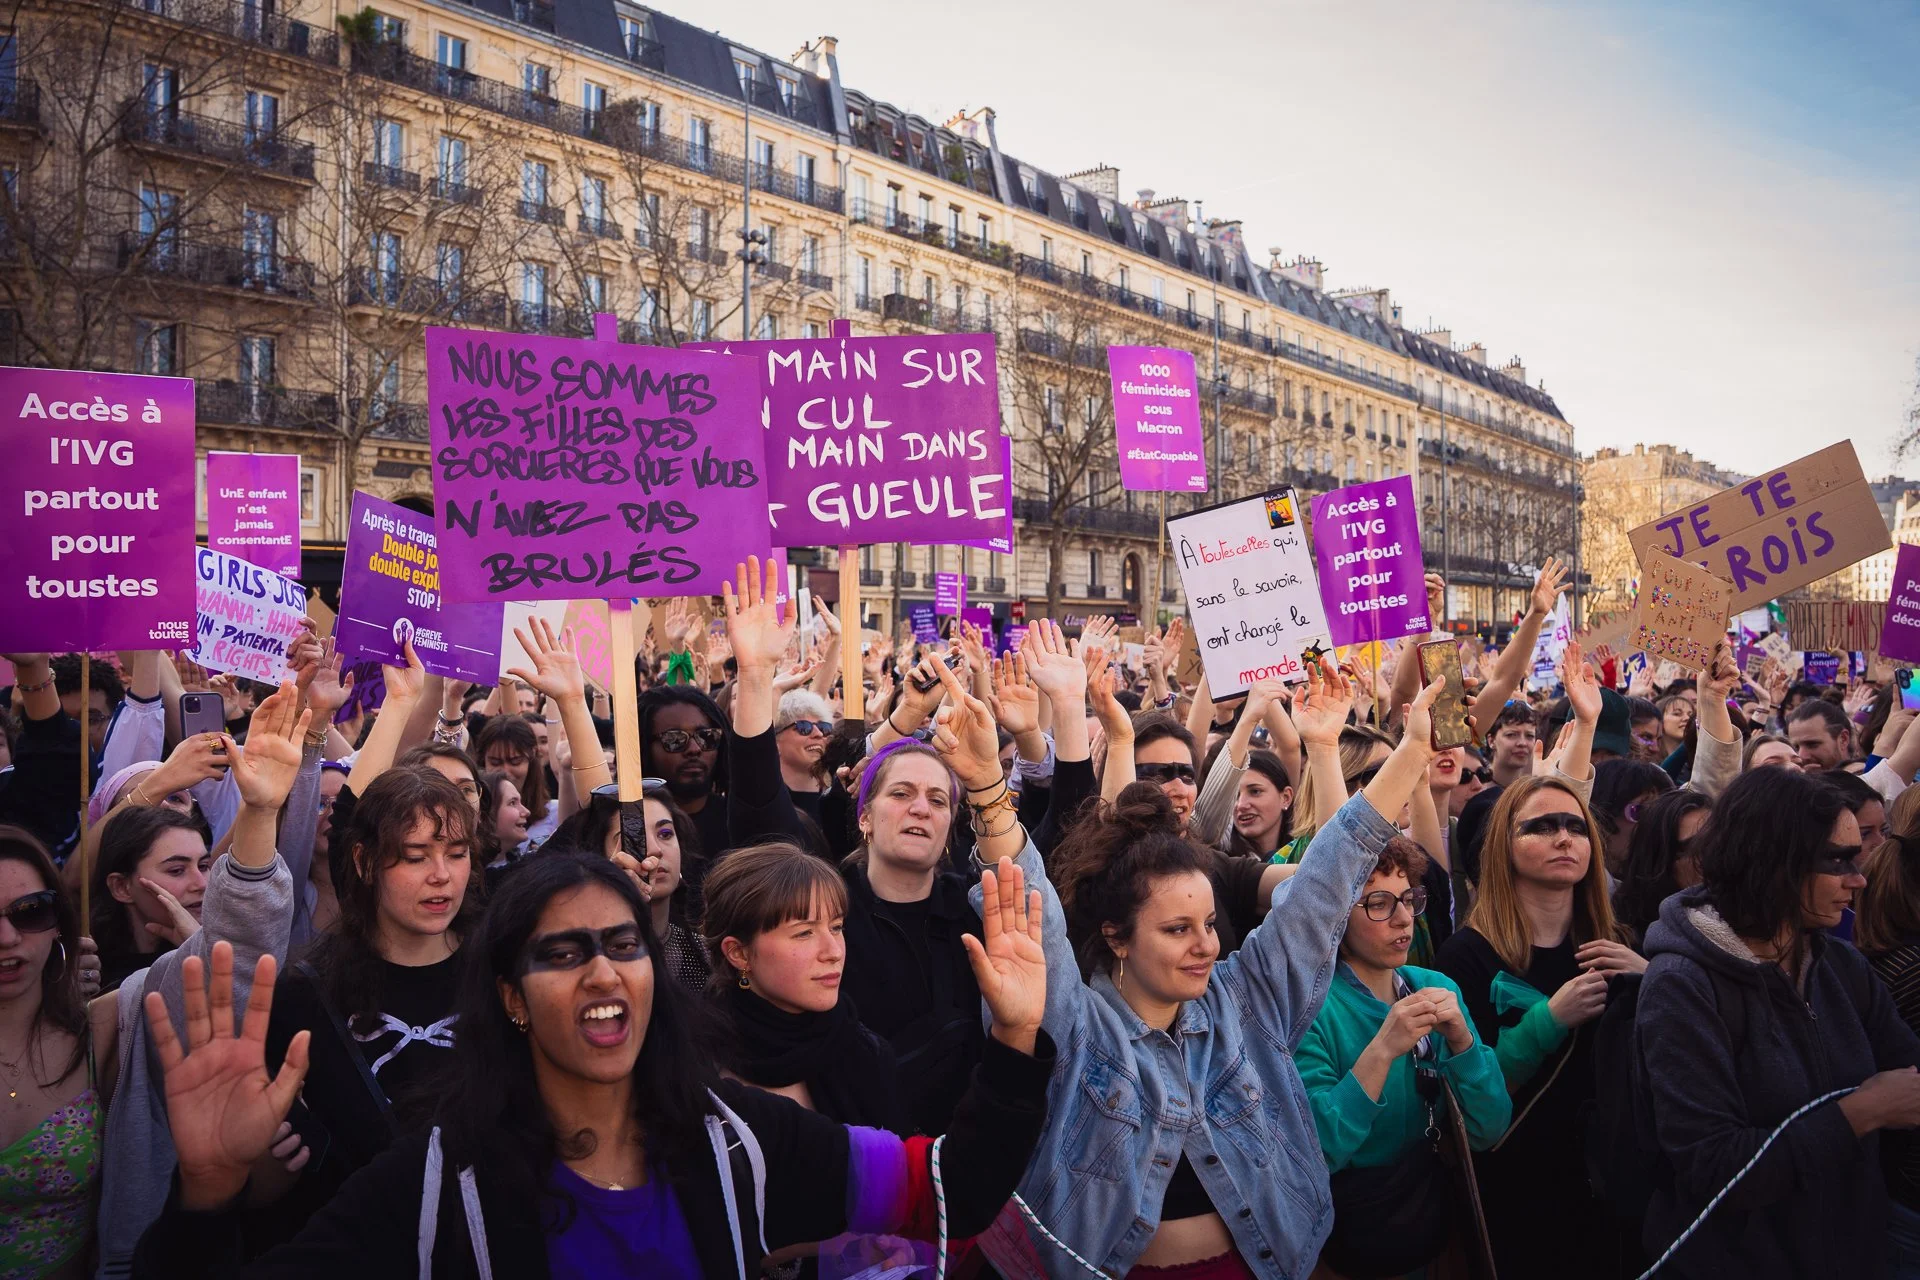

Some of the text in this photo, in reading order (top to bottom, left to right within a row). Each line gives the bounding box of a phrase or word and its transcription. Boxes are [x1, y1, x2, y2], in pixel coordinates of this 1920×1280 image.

[448, 341, 542, 396] NOUS
[551, 356, 717, 415] SOMMES
[902, 349, 986, 389] SUR
[1140, 363, 1171, 378] 1000
[1121, 381, 1191, 398] féminicides
[19, 392, 162, 424] Accès à
[797, 392, 893, 430] CUL
[1144, 405, 1172, 415] sous
[442, 397, 510, 441] LES
[632, 417, 699, 452] DES
[1137, 421, 1183, 435] Macron
[788, 427, 988, 469] MAIN DANS
[1127, 448, 1198, 463] #ÉtatCoupable
[437, 442, 760, 496] SORCIERES QUE VOUS
[24, 486, 160, 515] partout
[219, 487, 288, 499] UnE enfant
[807, 473, 1006, 529] GUEULE
[1327, 491, 1397, 519] Accès à
[234, 519, 274, 532] jamais
[362, 508, 394, 532] Après
[397, 519, 407, 537] le
[617, 500, 699, 535] PAS
[1655, 471, 1796, 559] JE TE
[51, 534, 136, 561] pour
[217, 535, 292, 546] consentantE
[383, 533, 439, 570] Double jo
[1180, 534, 1199, 569] À
[481, 542, 701, 593] BRULÉS
[1333, 541, 1403, 571] partout
[26, 573, 159, 599] toustes
[198, 549, 266, 599] GIRLS
[369, 552, 440, 593] double expl
[1347, 570, 1393, 593] pour
[407, 587, 435, 610] STOP
[1196, 593, 1226, 608] sans
[1233, 578, 1249, 597] le
[1340, 593, 1408, 615] toustes
[158, 621, 189, 630] nous
[416, 626, 442, 642] #GREVE
[1207, 605, 1311, 649] ont changé le
[1405, 621, 1427, 631] toutes
[1408, 616, 1426, 624] nous
[149, 629, 189, 640] toutes
[414, 636, 448, 653] FEMINISTE
